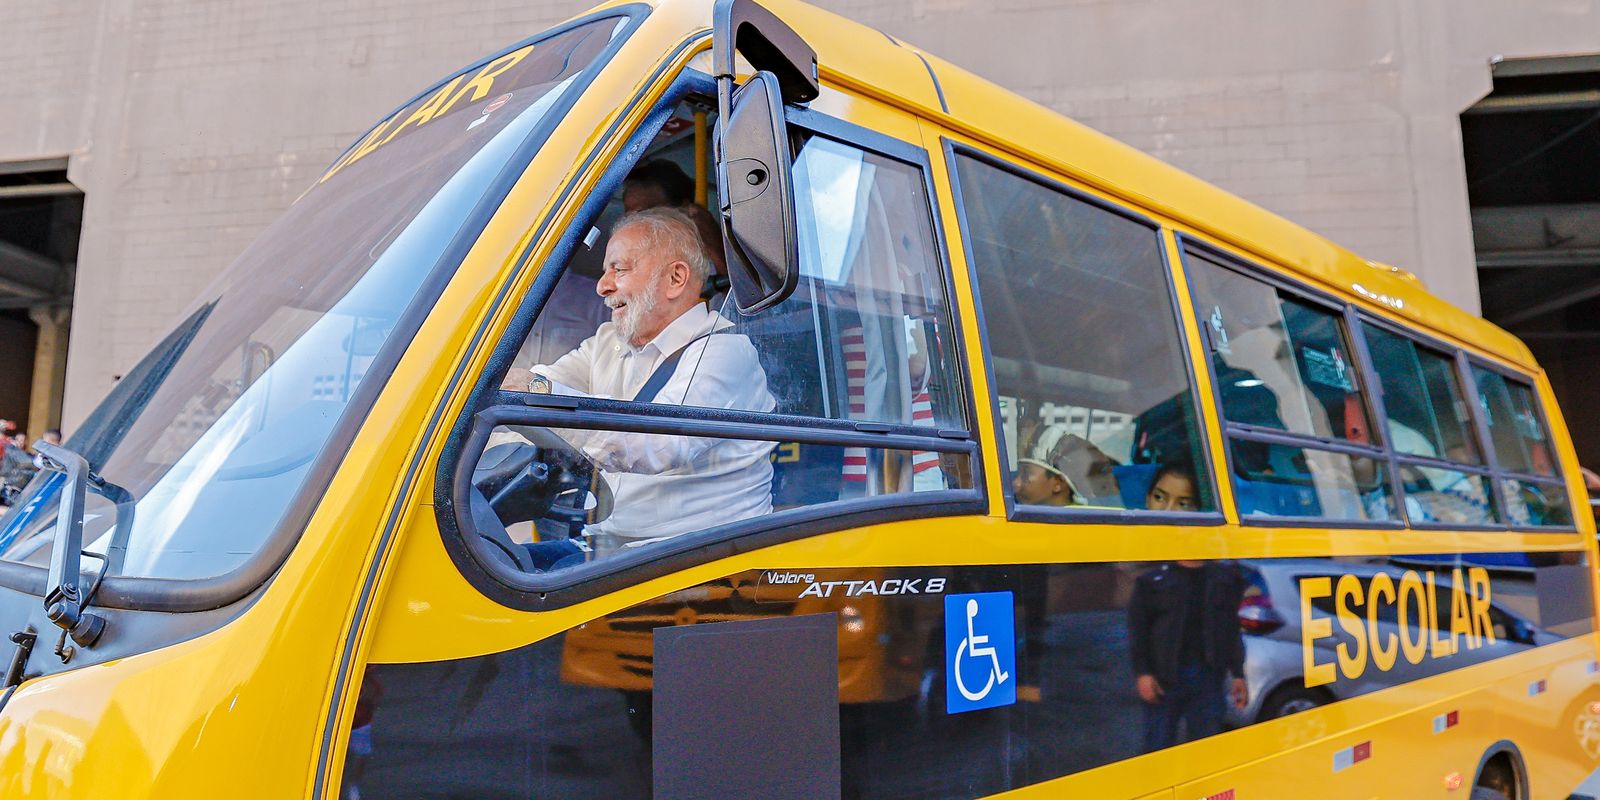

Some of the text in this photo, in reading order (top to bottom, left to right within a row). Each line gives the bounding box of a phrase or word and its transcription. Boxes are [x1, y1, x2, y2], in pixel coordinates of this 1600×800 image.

[767, 571, 815, 584] Volare
[798, 577, 946, 599] ATTACK 8
[1299, 566, 1497, 689] ESCOLAR
